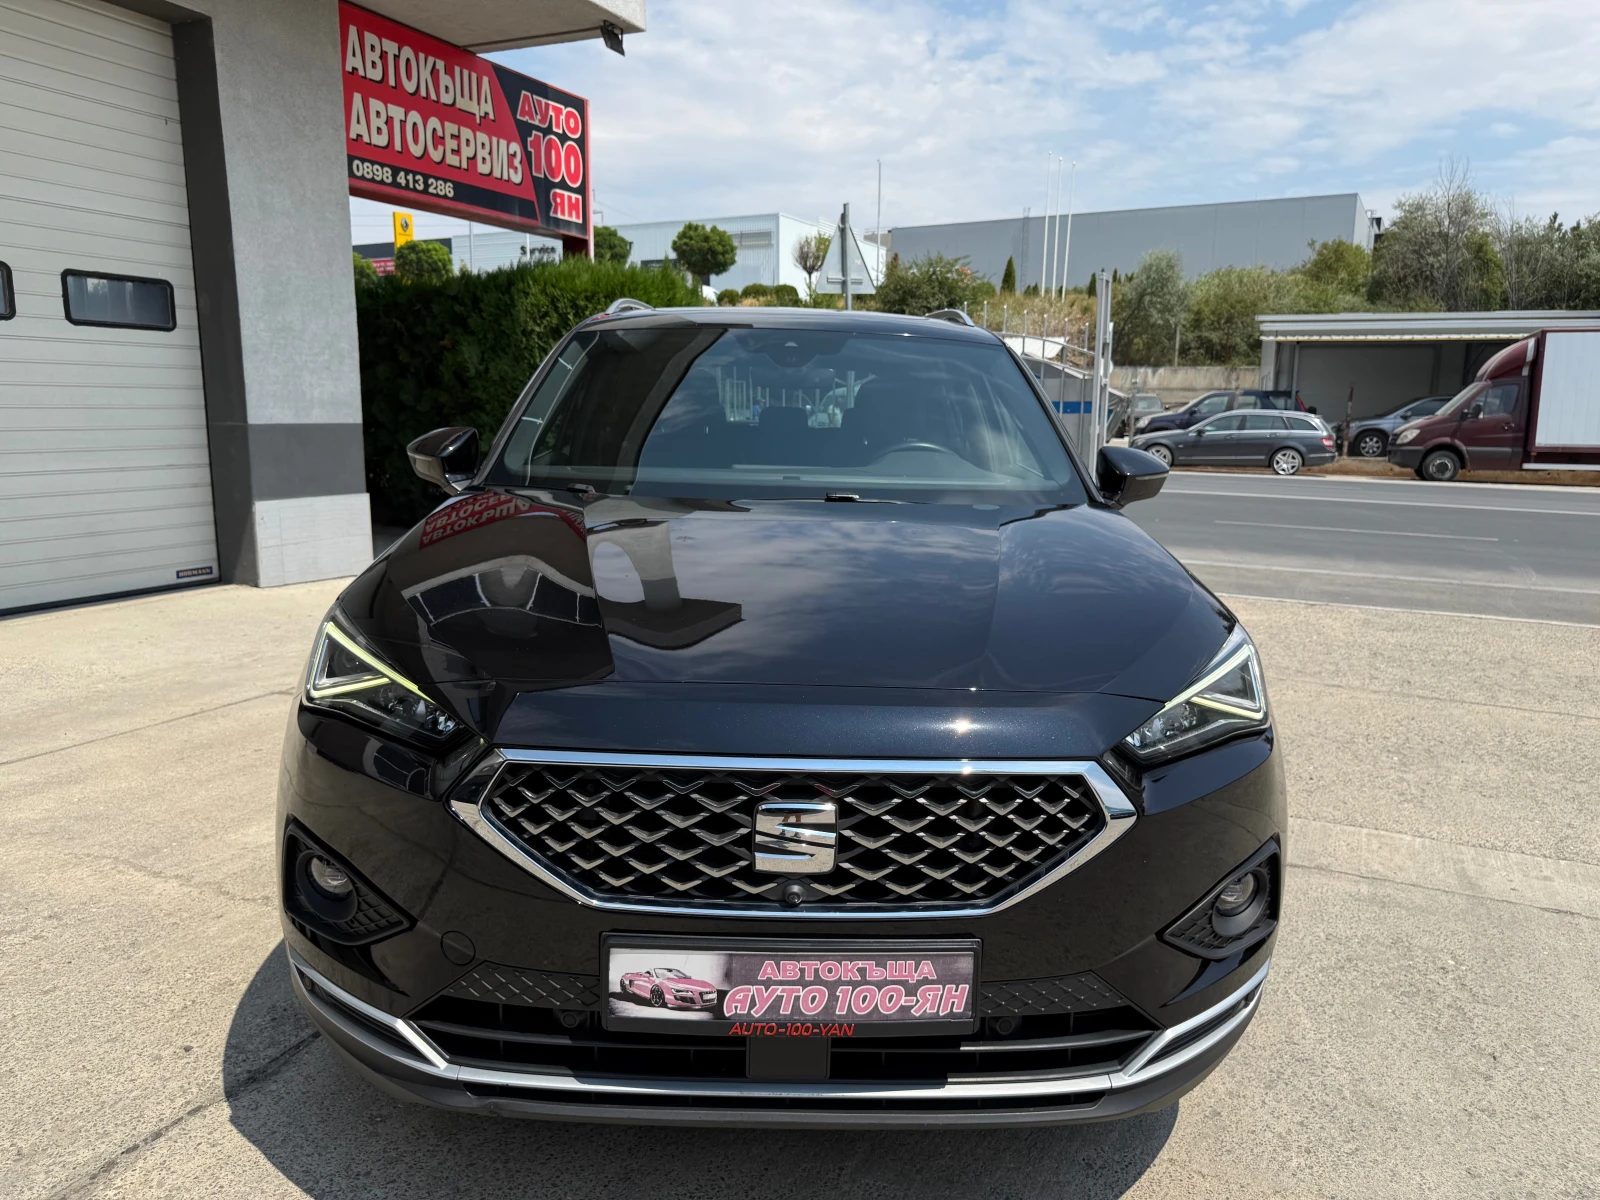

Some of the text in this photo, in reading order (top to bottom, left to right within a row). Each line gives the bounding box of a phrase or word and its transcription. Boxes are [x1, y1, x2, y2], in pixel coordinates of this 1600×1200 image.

[345, 25, 495, 125] АВТОКЪЩА
[517, 90, 582, 139] АУТО
[349, 92, 524, 186] АВТОСЕРВИЗ
[528, 130, 583, 188] 100
[352, 159, 455, 198] 0898 413 286
[550, 189, 583, 223] ЯН
[520, 244, 556, 256] Srvice
[758, 960, 937, 983] АВТОКЪЩА
[723, 984, 969, 1017] АУТО 100-ЯН
[728, 1022, 855, 1037] AUTO-100-YAN
